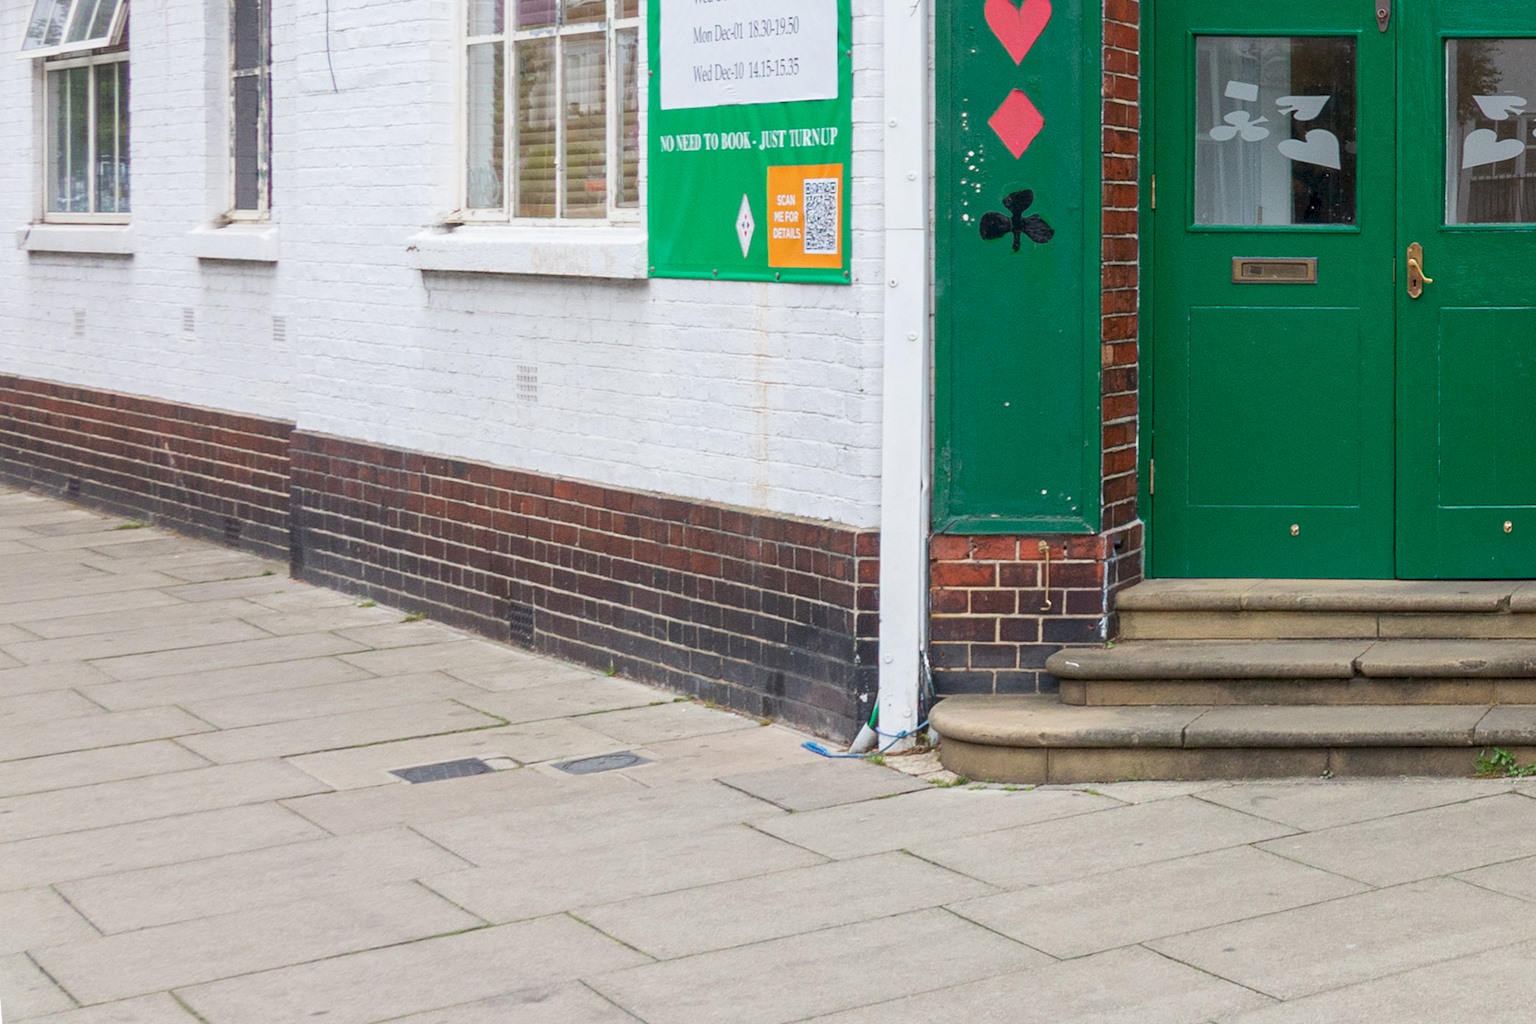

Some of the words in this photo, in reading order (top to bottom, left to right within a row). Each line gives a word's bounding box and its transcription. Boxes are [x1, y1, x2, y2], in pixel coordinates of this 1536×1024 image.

[693, 26, 713, 44] Mon
[714, 22, 743, 42] Dec-01
[748, 16, 799, 38] 18.30-19.50
[693, 64, 712, 82] Wed
[714, 62, 744, 81] Dec-10
[748, 57, 799, 78] 14.15-15.35
[660, 135, 675, 152] NO
[676, 134, 701, 151] NEED
[703, 133, 719, 150] TO
[721, 131, 751, 150] BOOK
[759, 130, 786, 150] JUST
[777, 194, 796, 206] SCAN
[774, 211, 784, 222] ME
[785, 211, 799, 222] FOR
[773, 227, 801, 239] DETAILS
